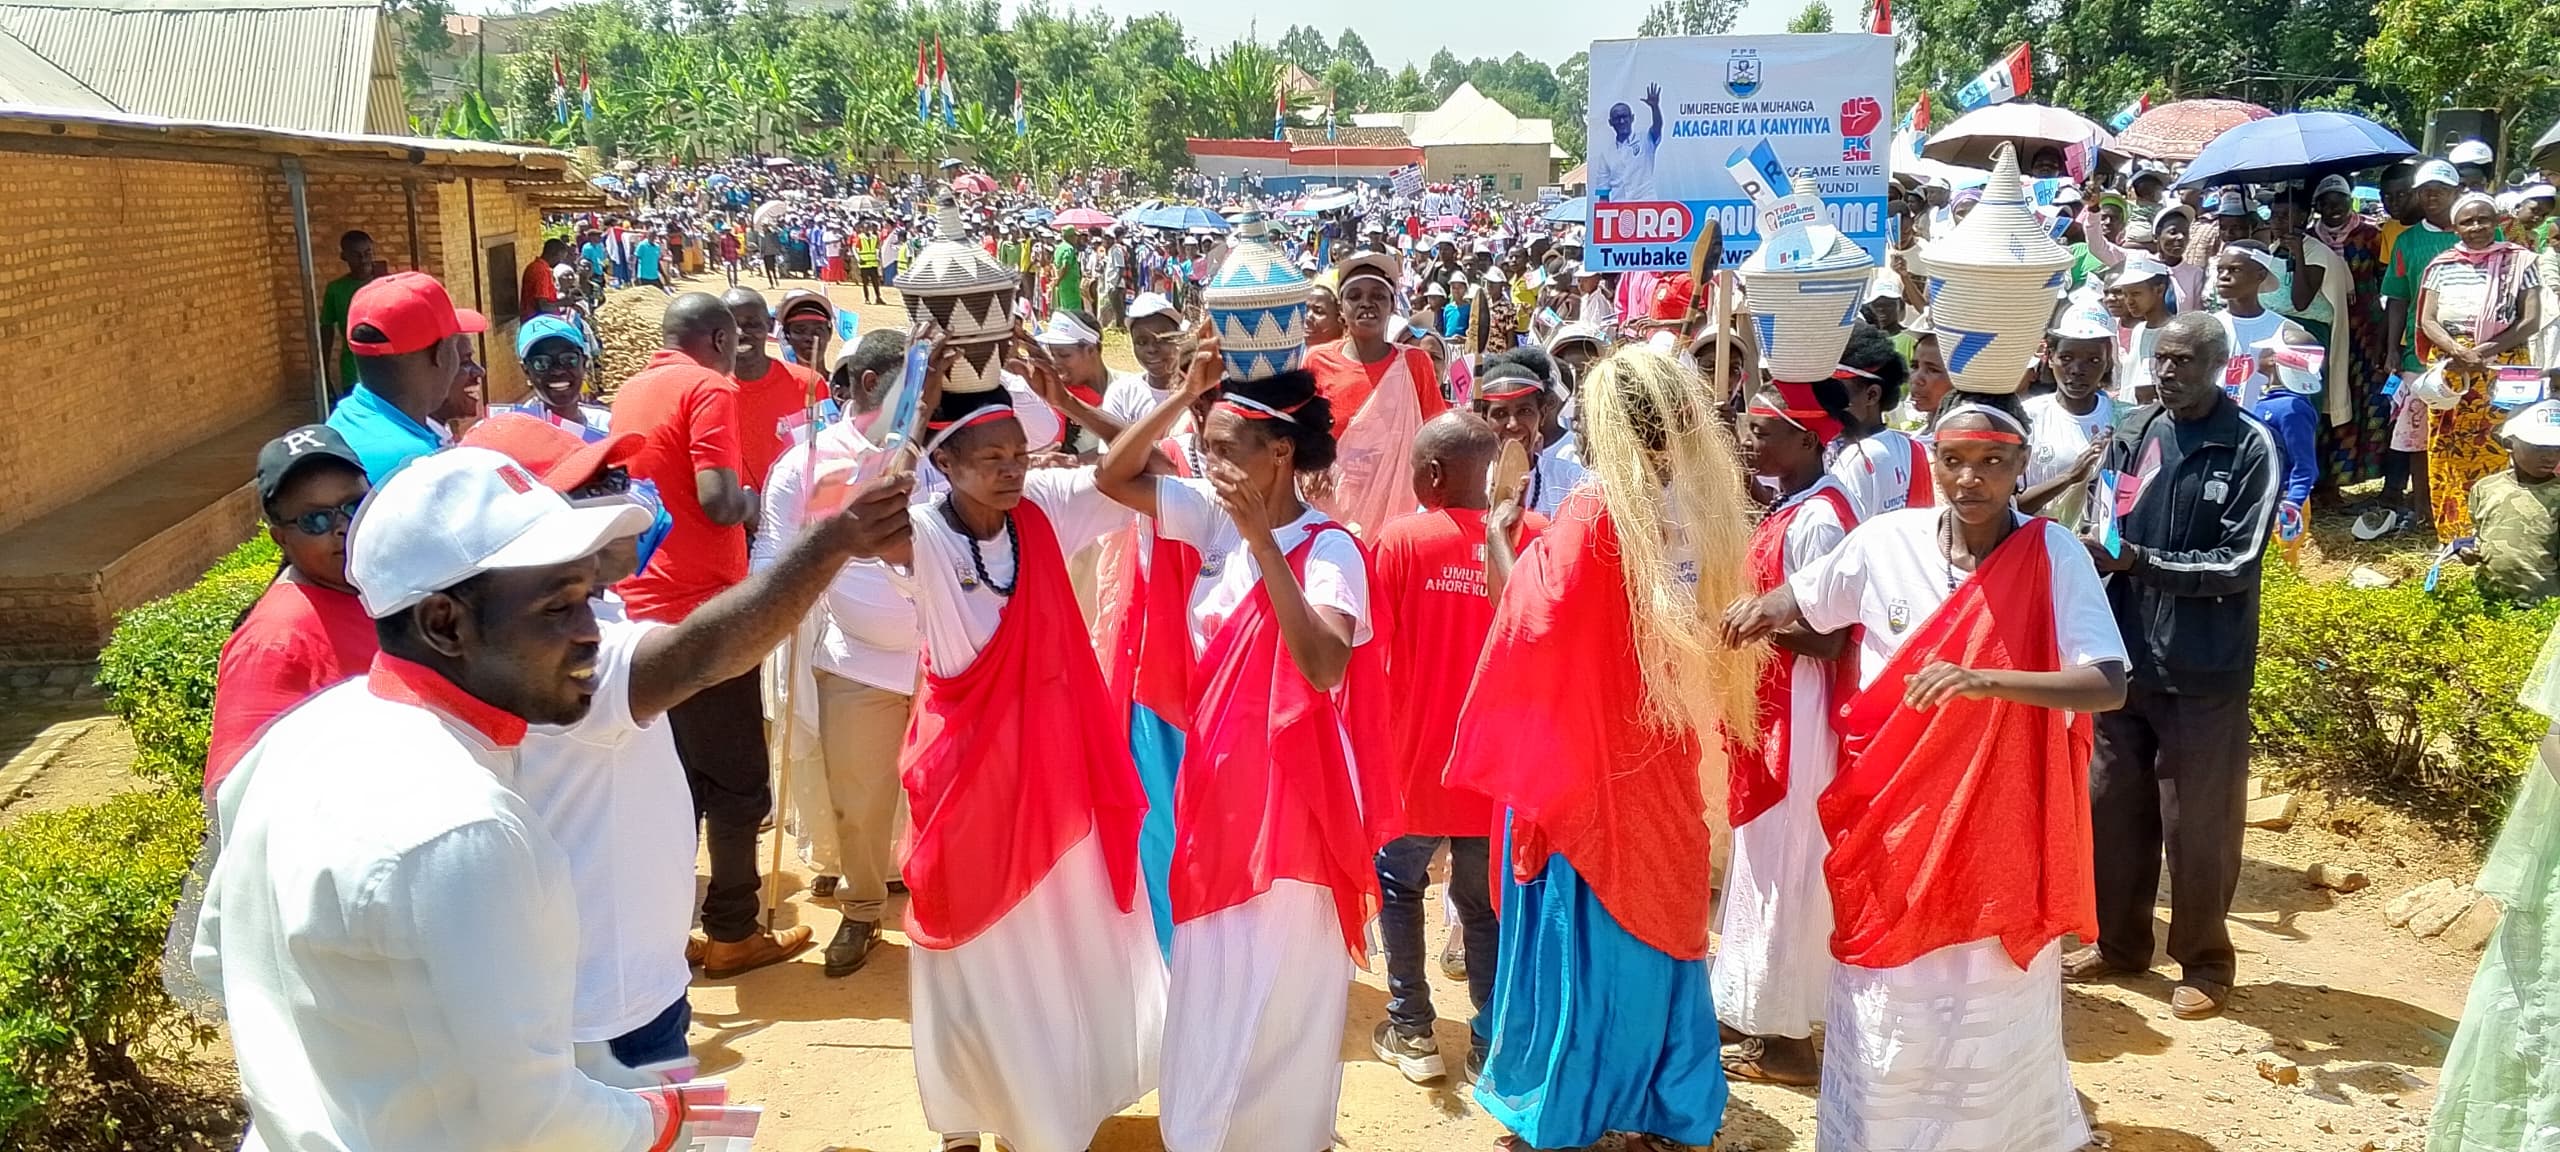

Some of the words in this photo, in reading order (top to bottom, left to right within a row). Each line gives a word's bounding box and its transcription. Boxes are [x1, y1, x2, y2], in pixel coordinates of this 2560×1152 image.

[1679, 102, 1740, 115] UMURENGE
[1741, 101, 1759, 114] WA
[1760, 100, 1815, 114] MUHANGA
[1672, 119, 1733, 138] AKAGARI
[1737, 119, 1760, 137] KA
[1762, 116, 1831, 136] KANYINYA
[1785, 166, 1841, 178] KAAME
[1845, 164, 1881, 177] NIWE
[1595, 207, 1684, 240] TORA
[1704, 204, 1760, 237] PAU
[1600, 248, 1688, 267] Twubake
[1424, 578, 1471, 595] AHORE
[1472, 583, 1488, 598] KU
